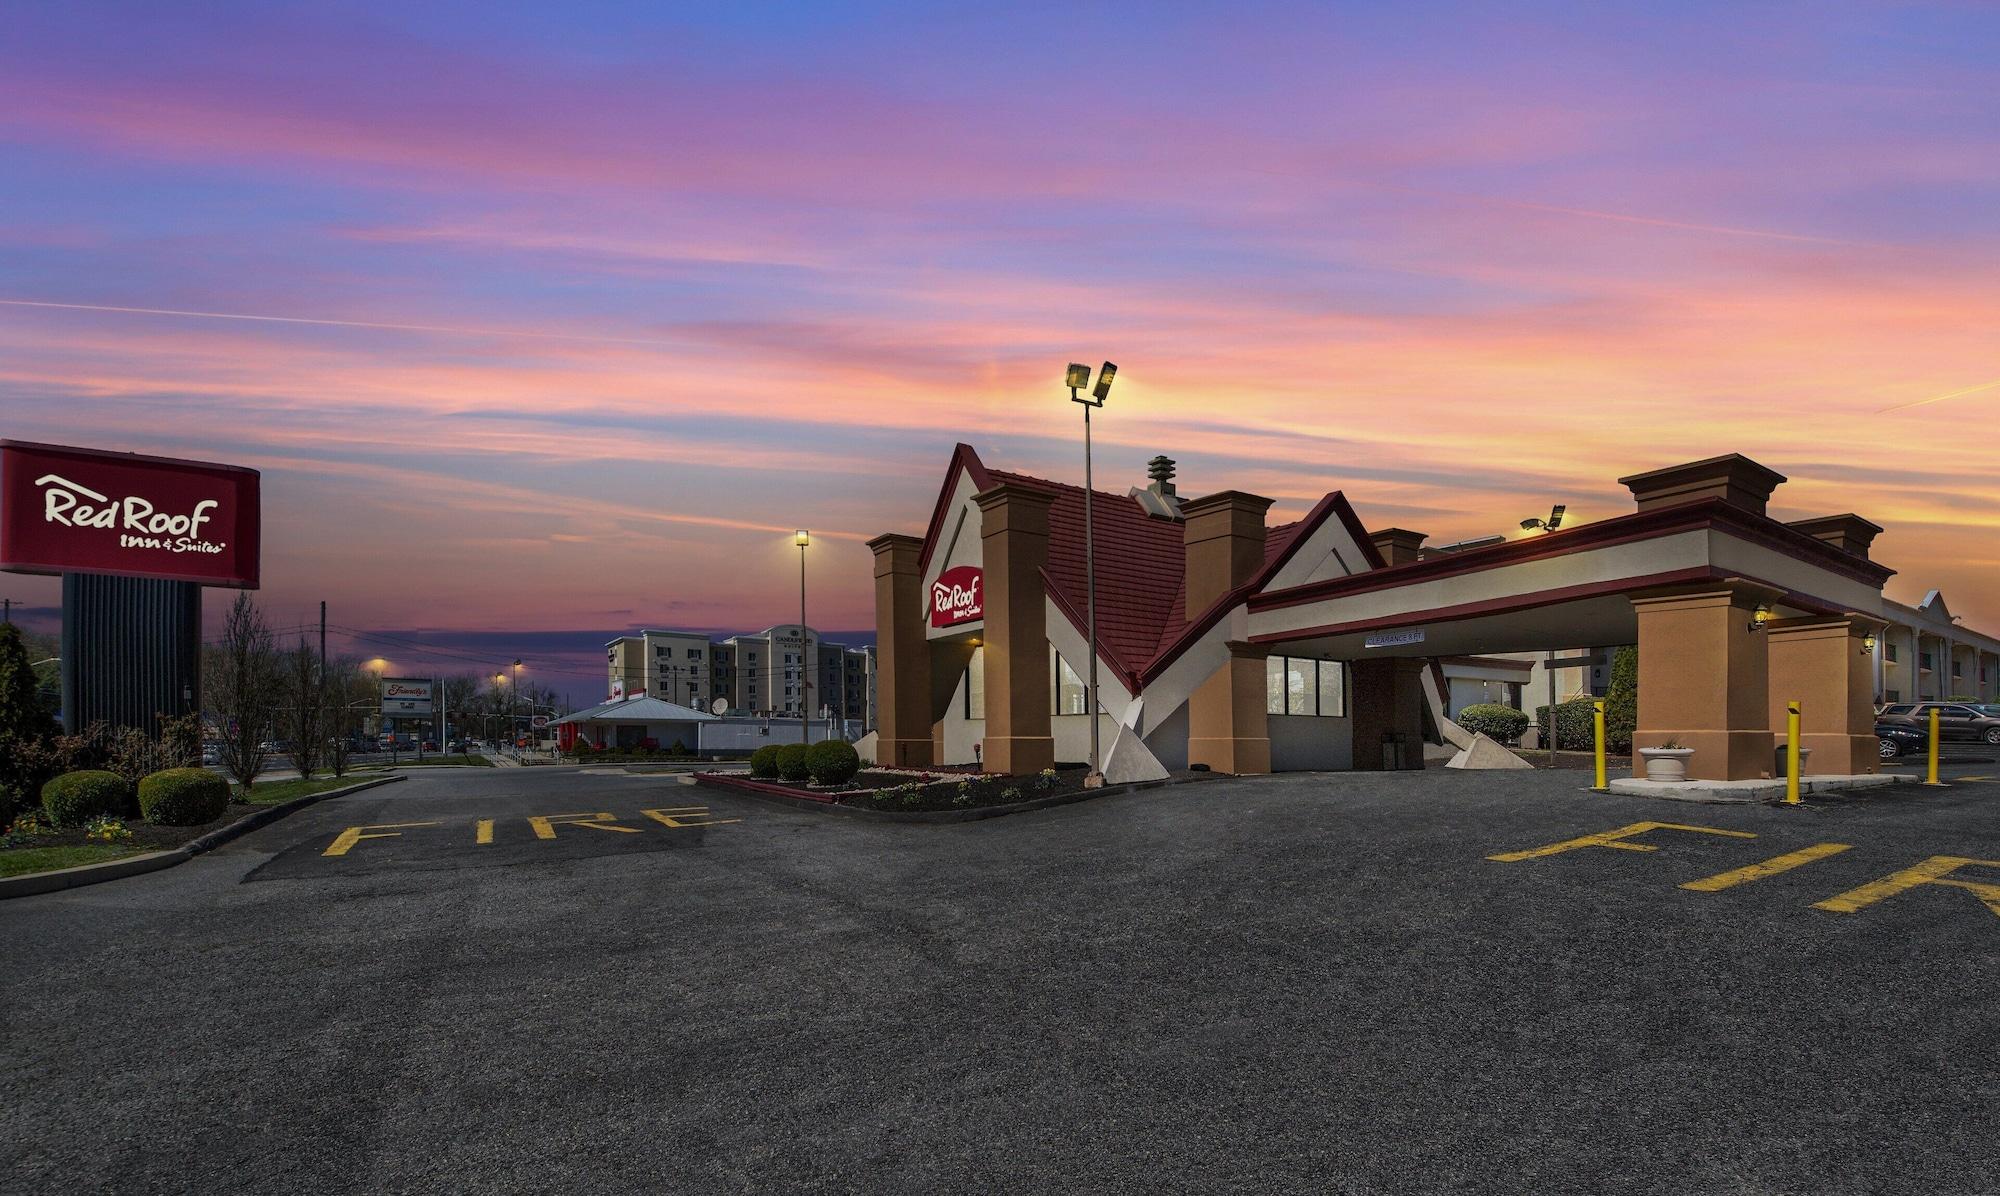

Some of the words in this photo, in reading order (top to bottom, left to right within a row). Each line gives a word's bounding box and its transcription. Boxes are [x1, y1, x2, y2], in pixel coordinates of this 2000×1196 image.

[45, 488, 120, 527] Red
[123, 496, 218, 539] Roof
[162, 538, 172, 550] &
[172, 537, 226, 553] Suites
[935, 590, 954, 612] Red
[953, 576, 979, 607] Roof
[1367, 635, 1407, 645] CLEARANCE
[1408, 633, 1413, 641] 8
[321, 806, 742, 857] FIRE
